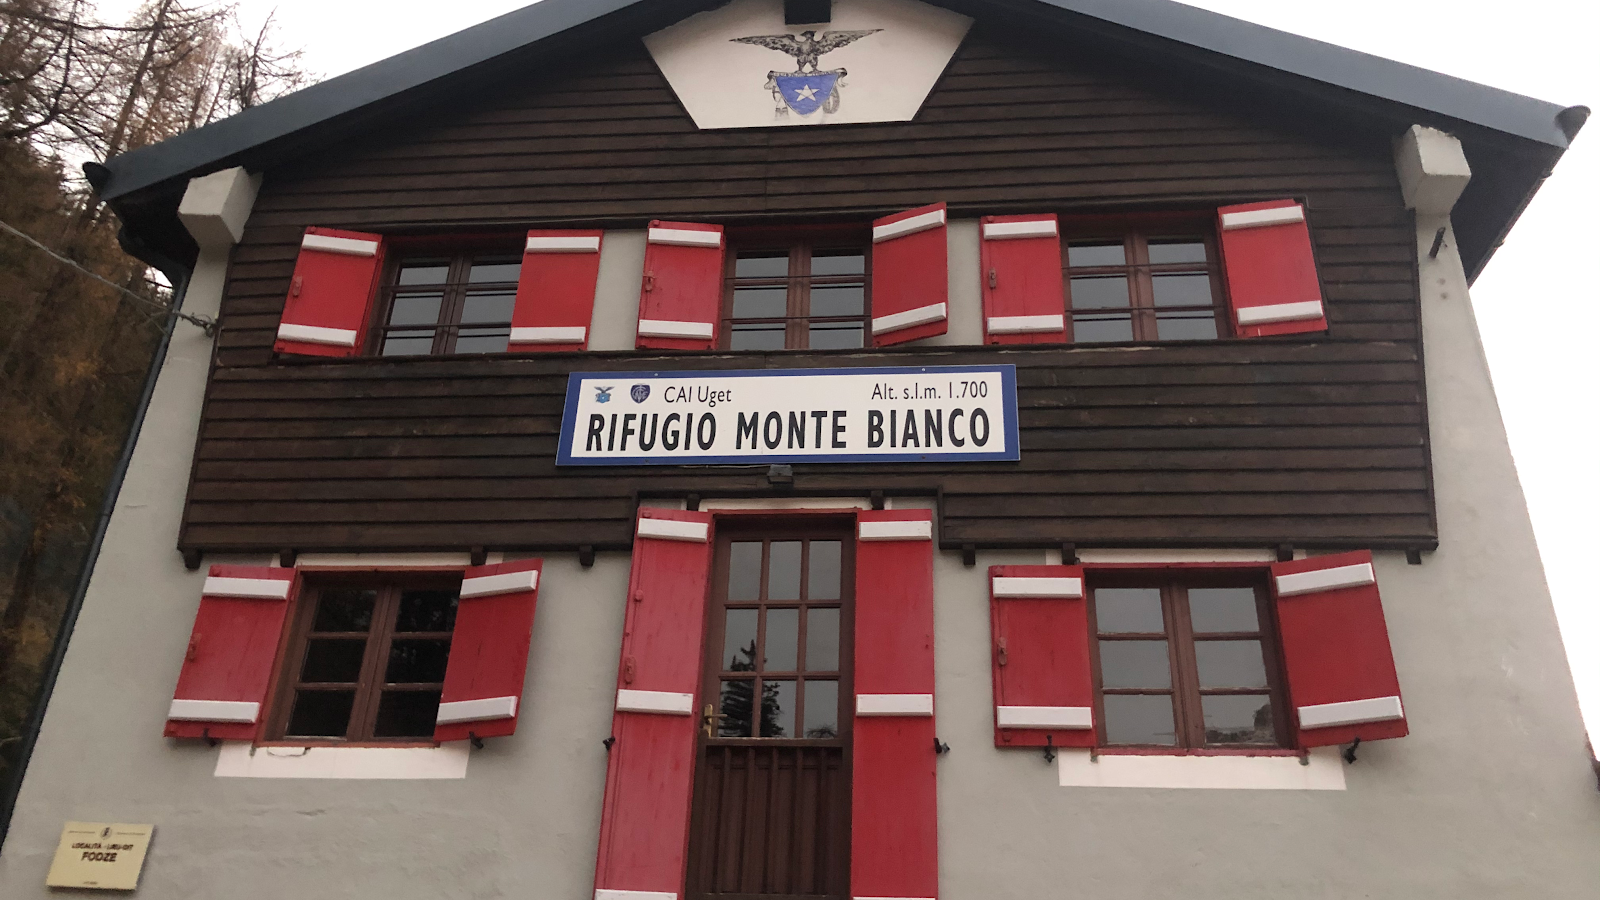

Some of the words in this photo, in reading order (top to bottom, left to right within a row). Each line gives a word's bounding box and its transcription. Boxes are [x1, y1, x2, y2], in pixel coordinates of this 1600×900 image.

[664, 386, 693, 403] CAI
[697, 386, 732, 408] Uget
[871, 382, 898, 400] Alt.
[903, 382, 942, 400] s.l.m.
[949, 380, 988, 399] 1.700
[586, 412, 717, 452] RIFUGIO
[736, 410, 847, 450] MONTE
[867, 408, 990, 449] BIANCO
